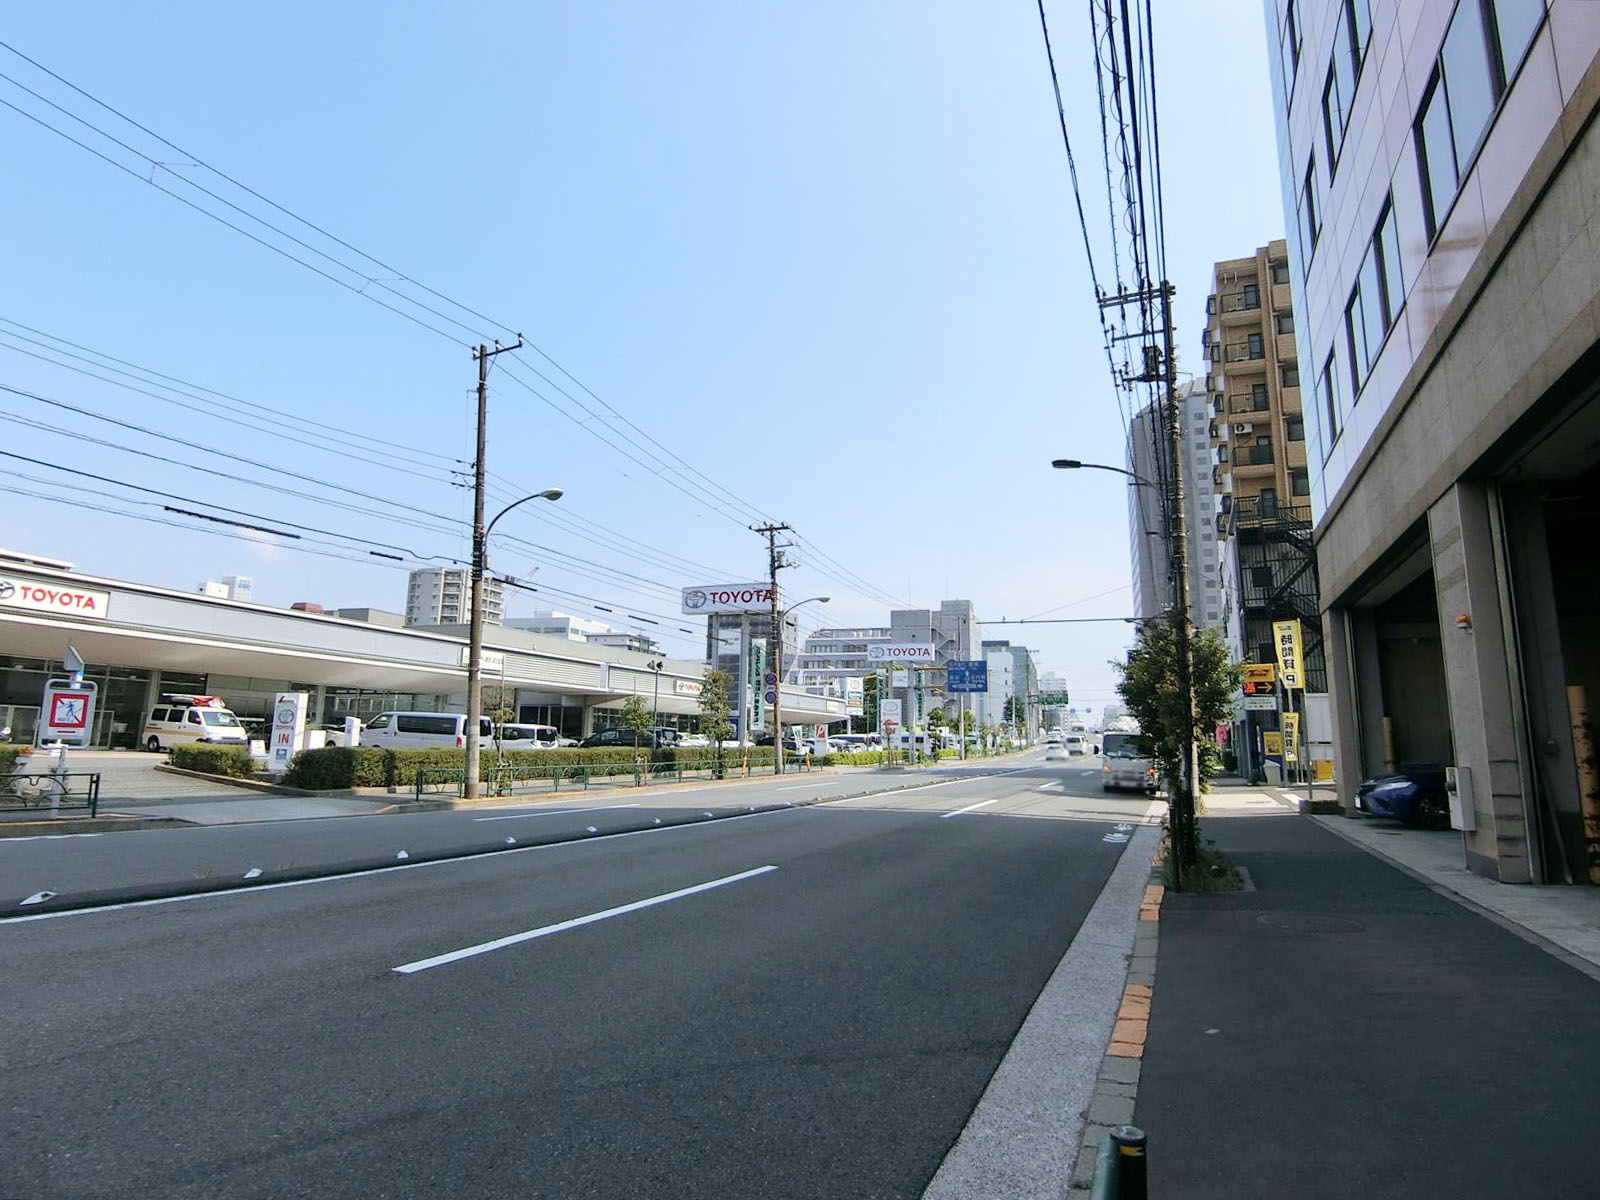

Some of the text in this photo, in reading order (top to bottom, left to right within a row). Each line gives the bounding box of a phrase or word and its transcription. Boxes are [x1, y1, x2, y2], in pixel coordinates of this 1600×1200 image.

[21, 586, 96, 610] TOYOTA
[710, 589, 774, 605] TOYOTA
[885, 647, 931, 657] TOYOTA
[278, 733, 290, 745] IN
